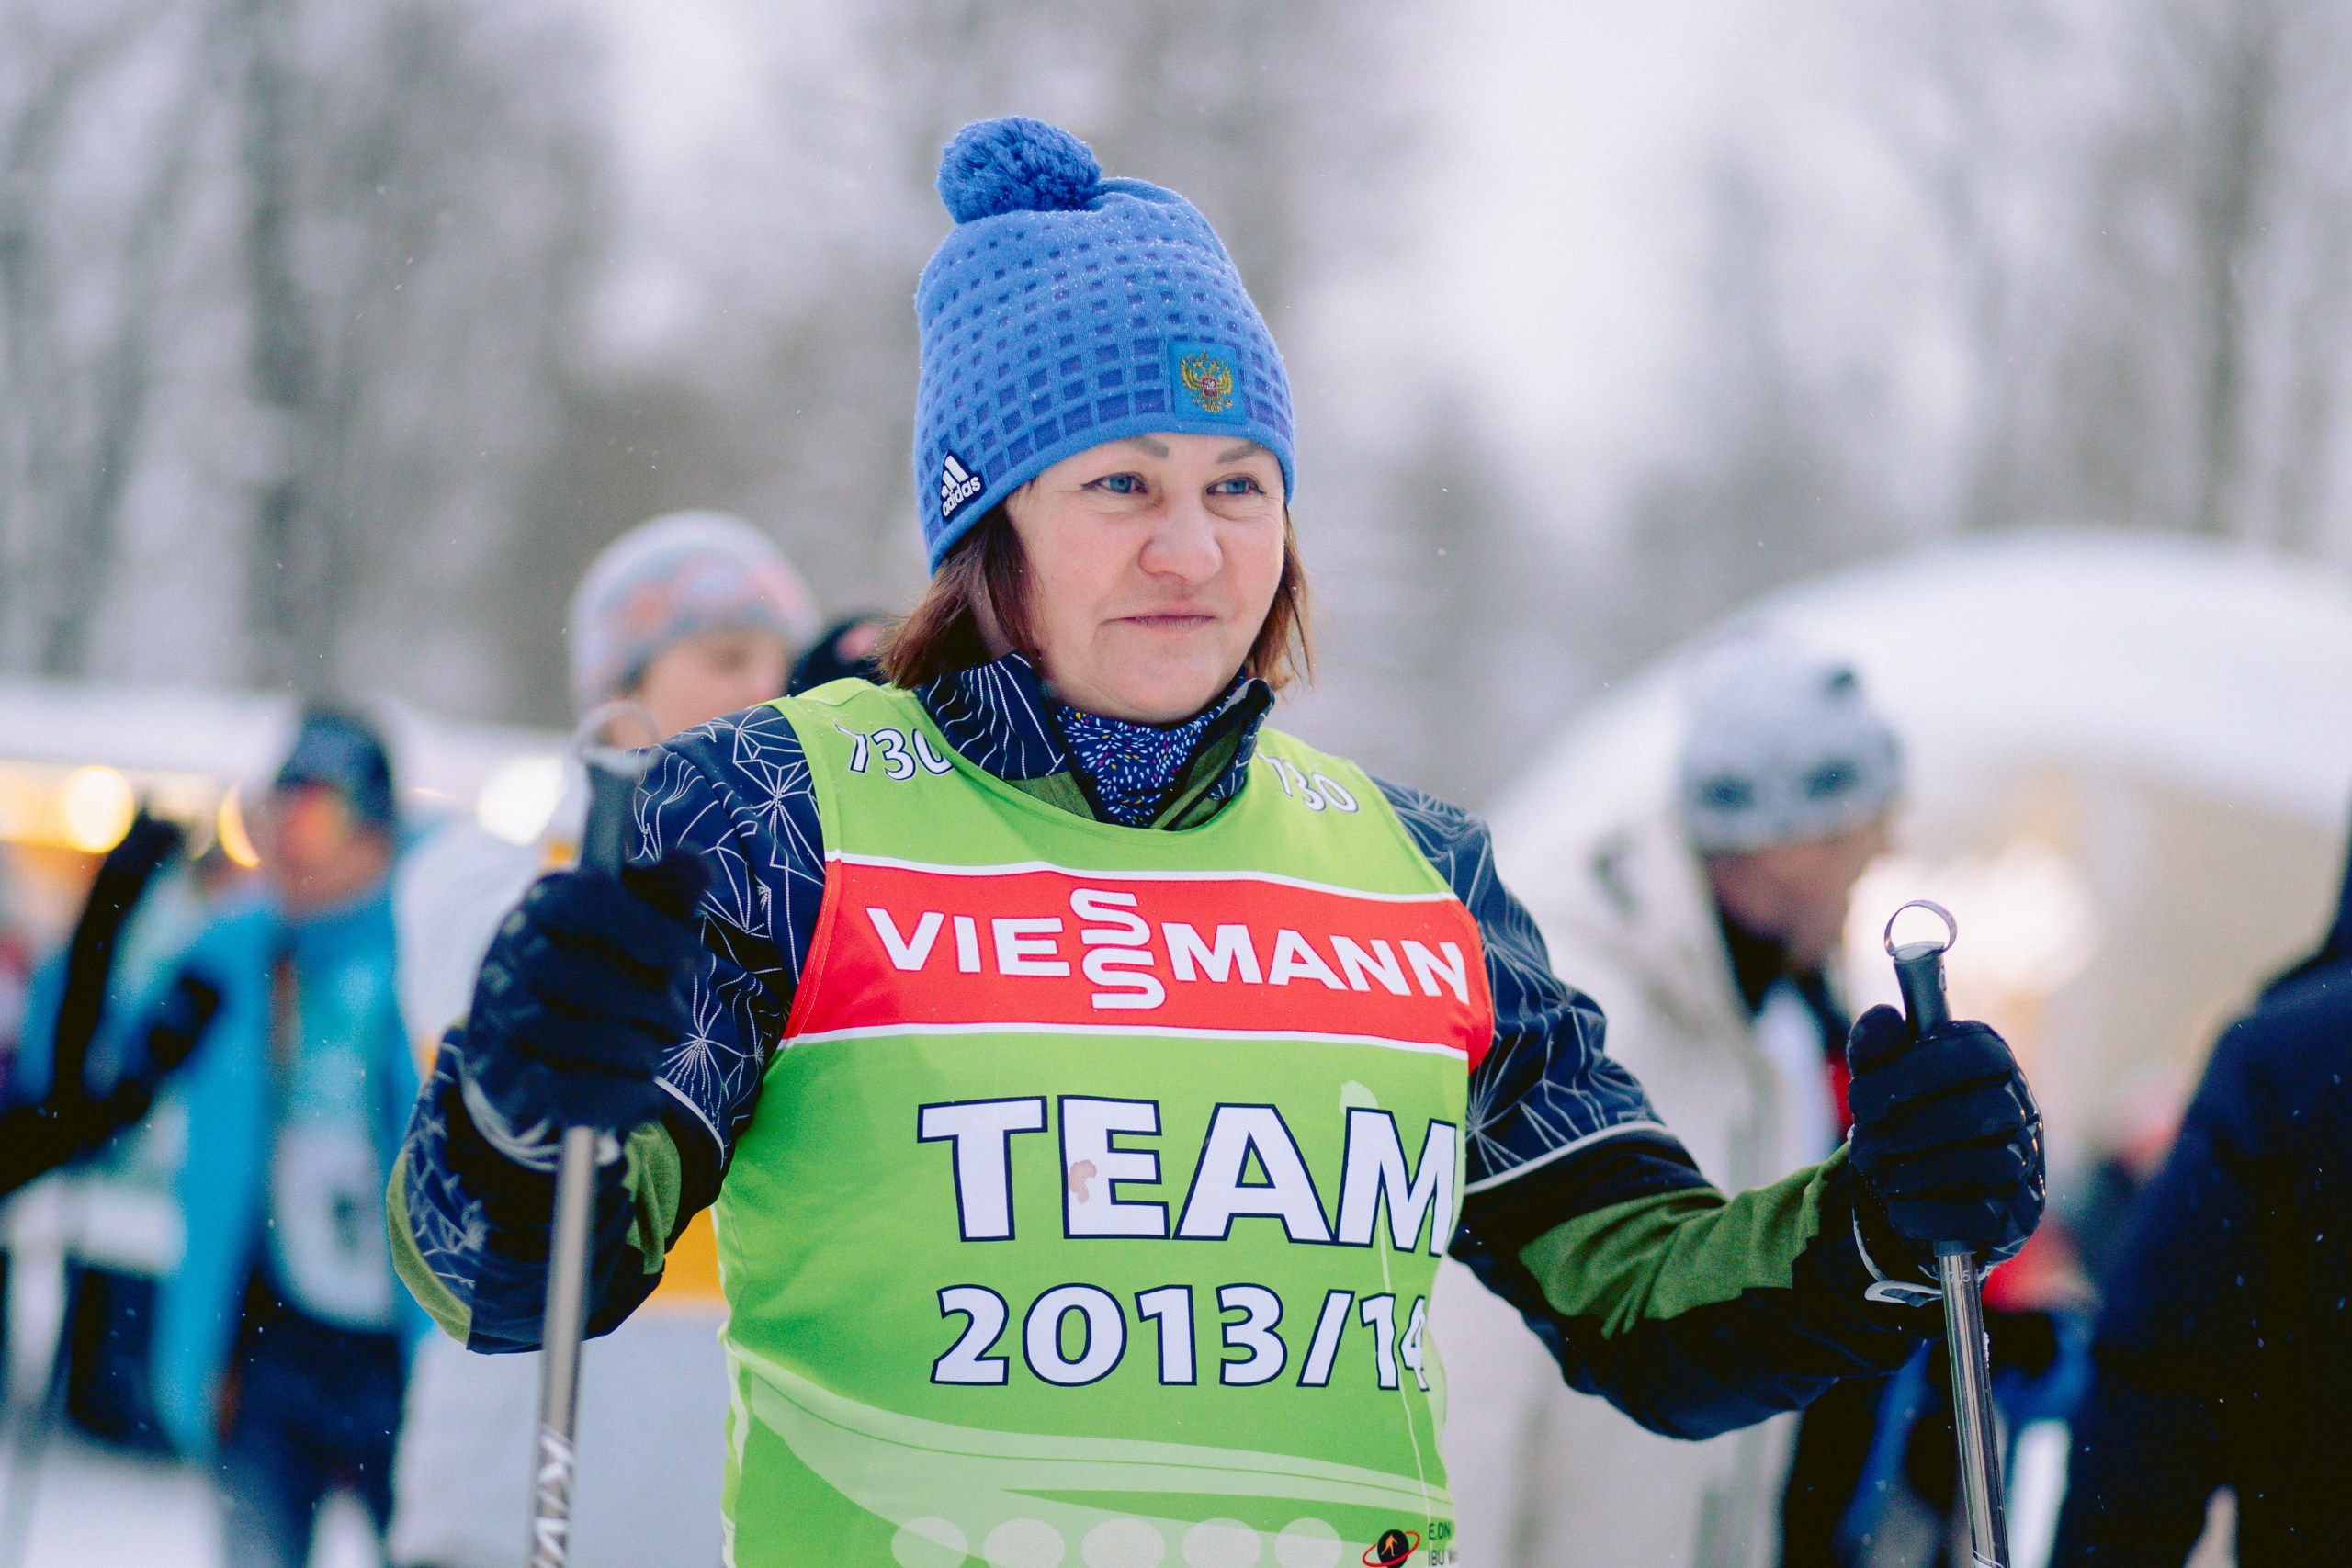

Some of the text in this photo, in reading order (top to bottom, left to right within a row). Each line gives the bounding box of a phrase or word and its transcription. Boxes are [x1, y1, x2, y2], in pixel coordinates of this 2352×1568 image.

[943, 477, 981, 516] adidas
[1256, 750, 1359, 813] 730
[865, 887, 1469, 1009] VIESSMANN
[918, 1095, 1457, 1258] TEAM
[930, 1282, 1430, 1393] 2013/14
